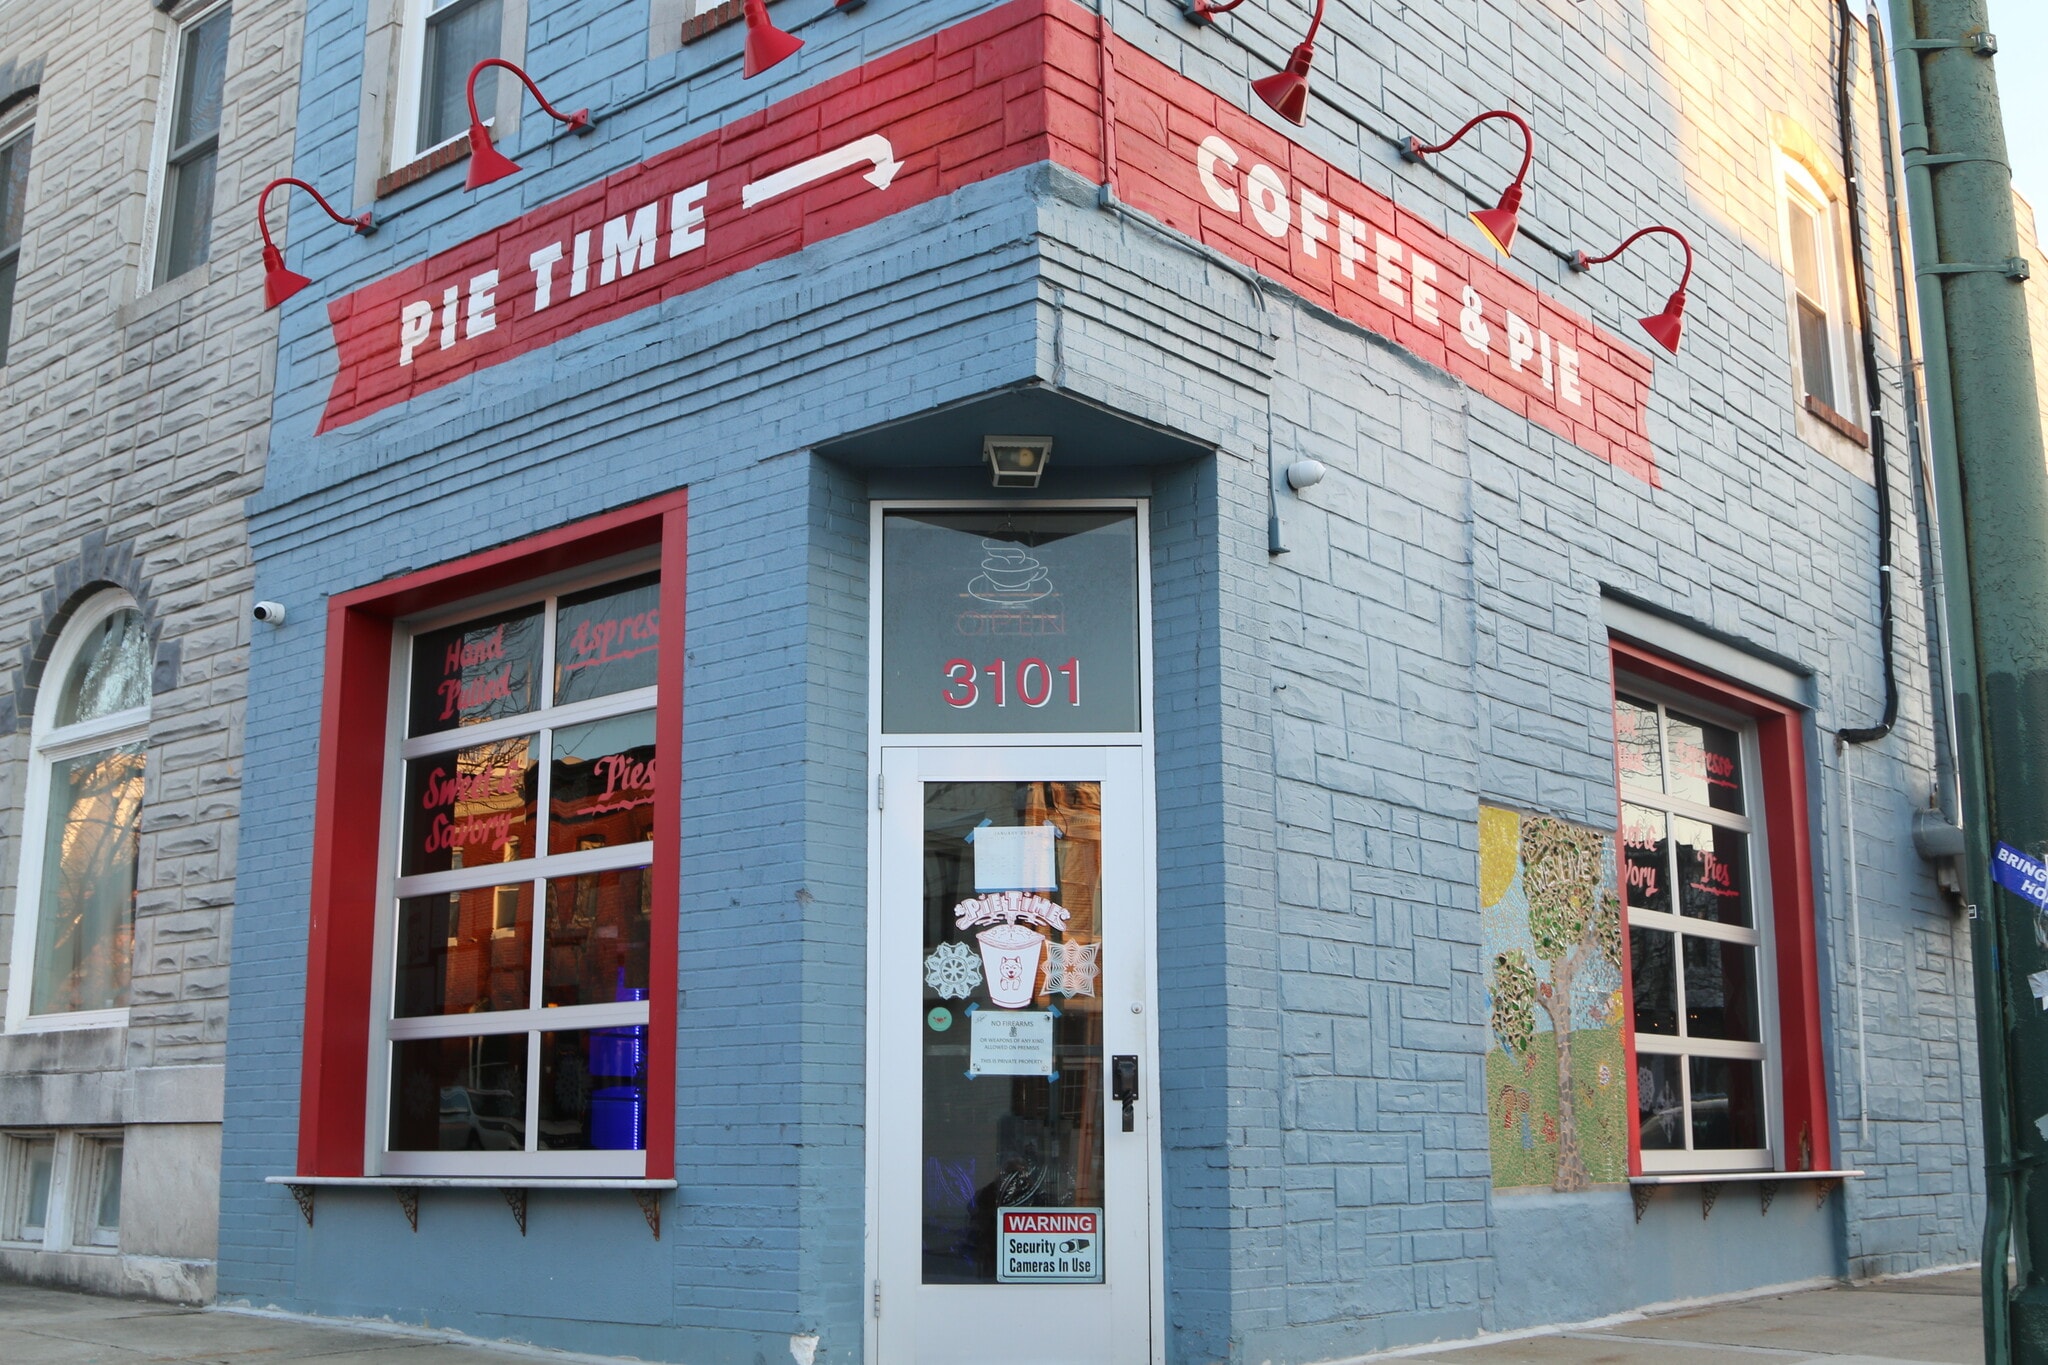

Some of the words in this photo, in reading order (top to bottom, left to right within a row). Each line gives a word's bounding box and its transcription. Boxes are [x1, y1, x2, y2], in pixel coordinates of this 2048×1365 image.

[400, 269, 498, 366] PIE
[529, 180, 708, 312] TIME
[1197, 135, 1440, 326] COFFEE
[1459, 285, 1490, 355] &
[1506, 309, 1581, 406] PIE
[443, 623, 506, 676] Hand
[942, 657, 1080, 708] 3101
[423, 763, 493, 810] Sweet
[425, 813, 512, 851] Savory
[1697, 849, 1730, 887] Pies
[1998, 848, 2047, 882] BRING
[2021, 879, 2048, 904] HO
[1008, 1216, 1092, 1231] WARNING
[1009, 1238, 1056, 1256] Security
[1009, 1257, 1055, 1273] Cameras
[1058, 1257, 1069, 1272] In
[1072, 1257, 1091, 1272] Use
